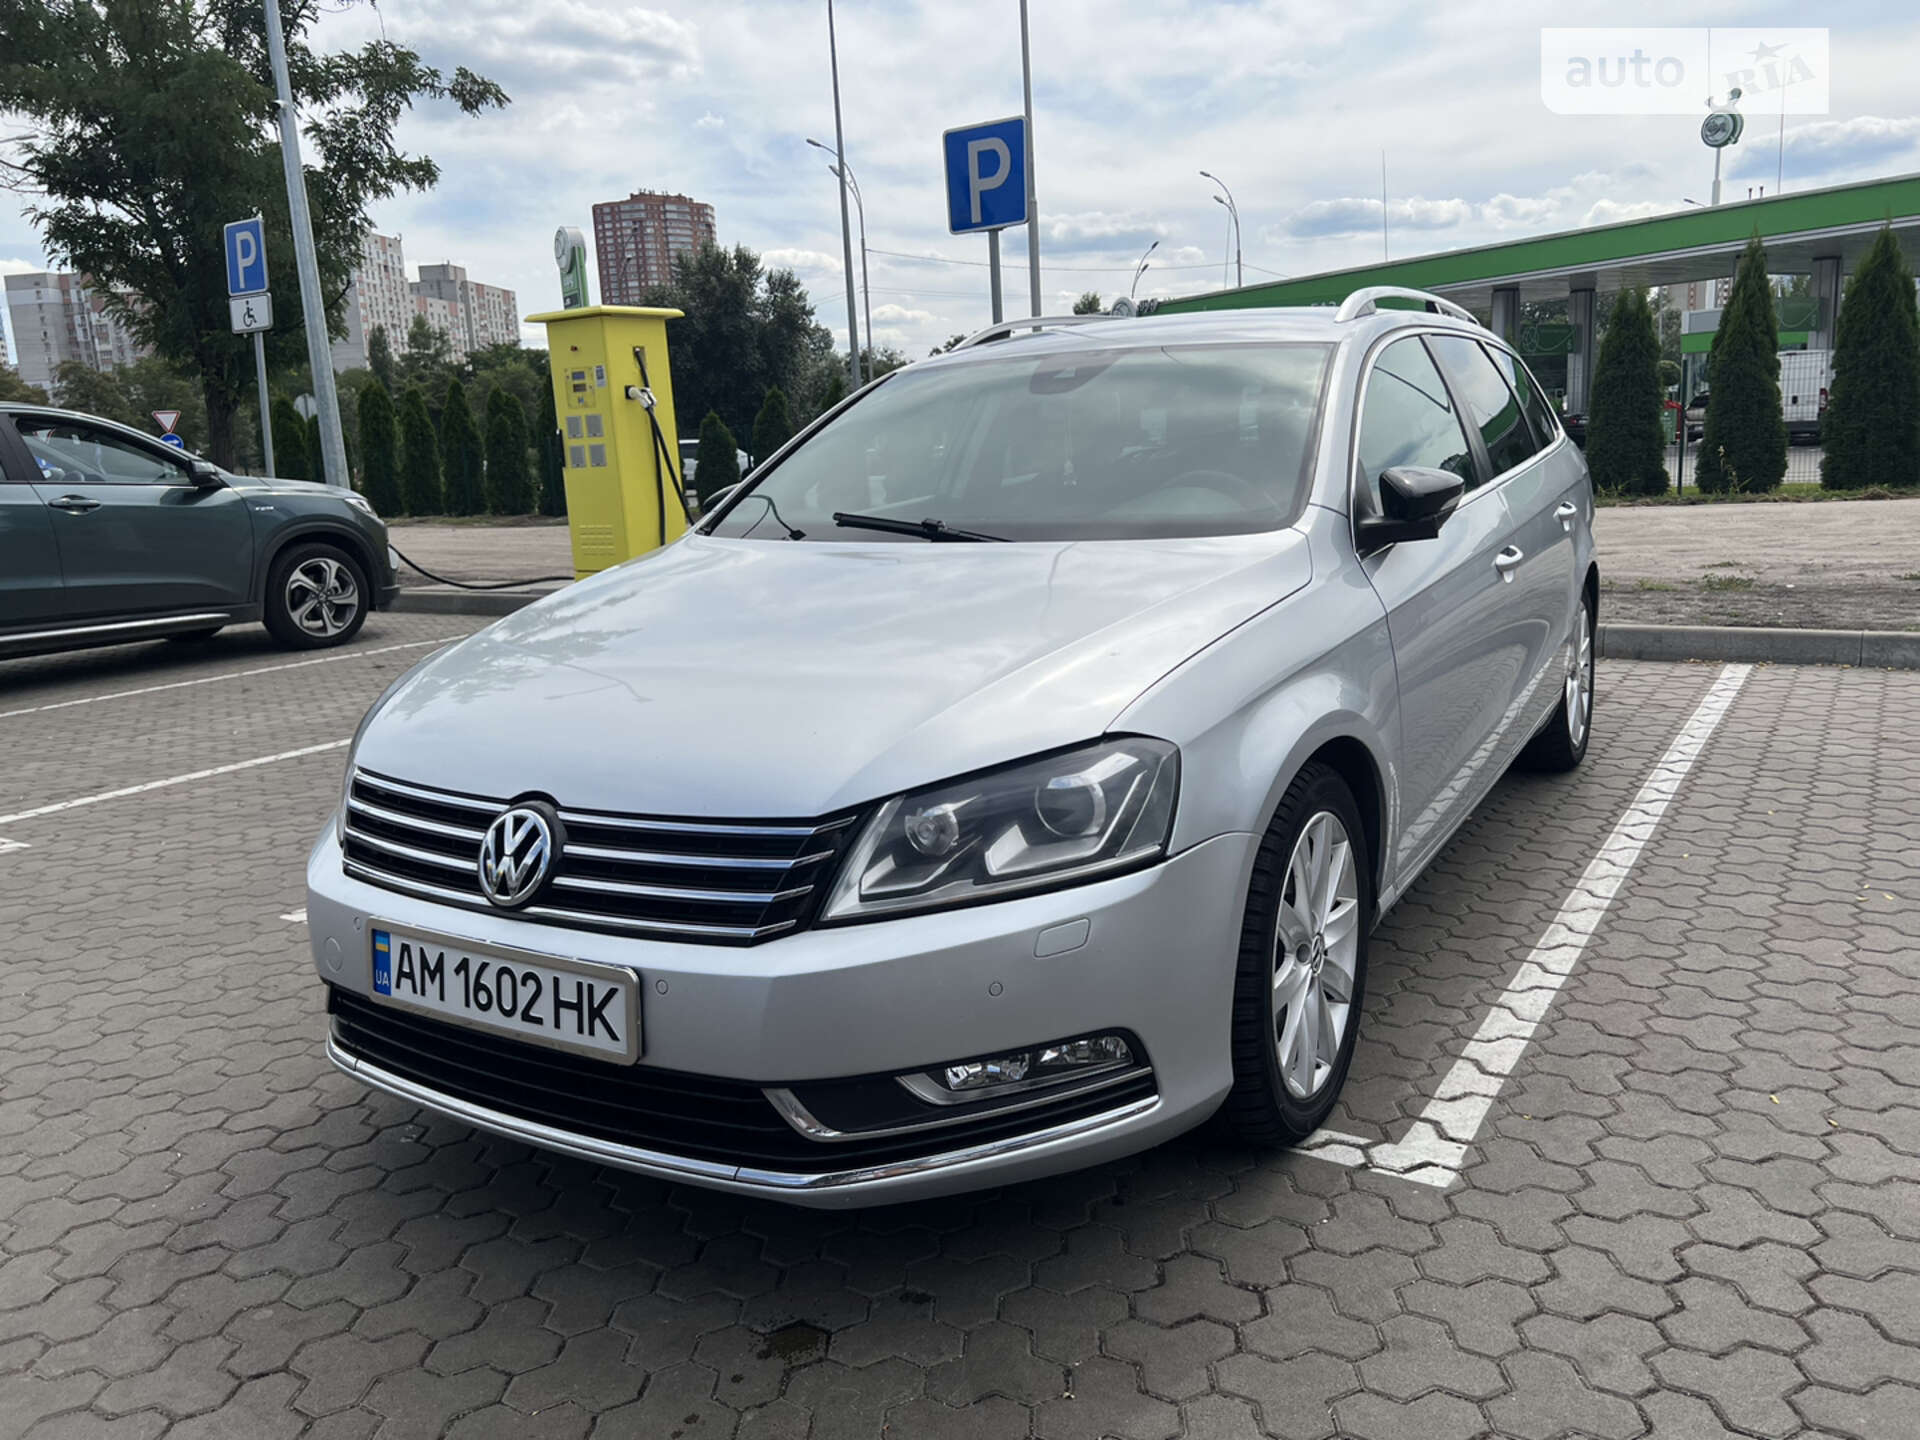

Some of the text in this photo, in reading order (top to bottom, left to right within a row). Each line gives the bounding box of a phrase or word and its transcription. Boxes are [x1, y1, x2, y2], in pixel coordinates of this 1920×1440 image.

[968, 137, 1011, 224] P
[235, 230, 257, 289] P
[375, 969, 390, 986] UA
[454, 957, 543, 1025] 1602
